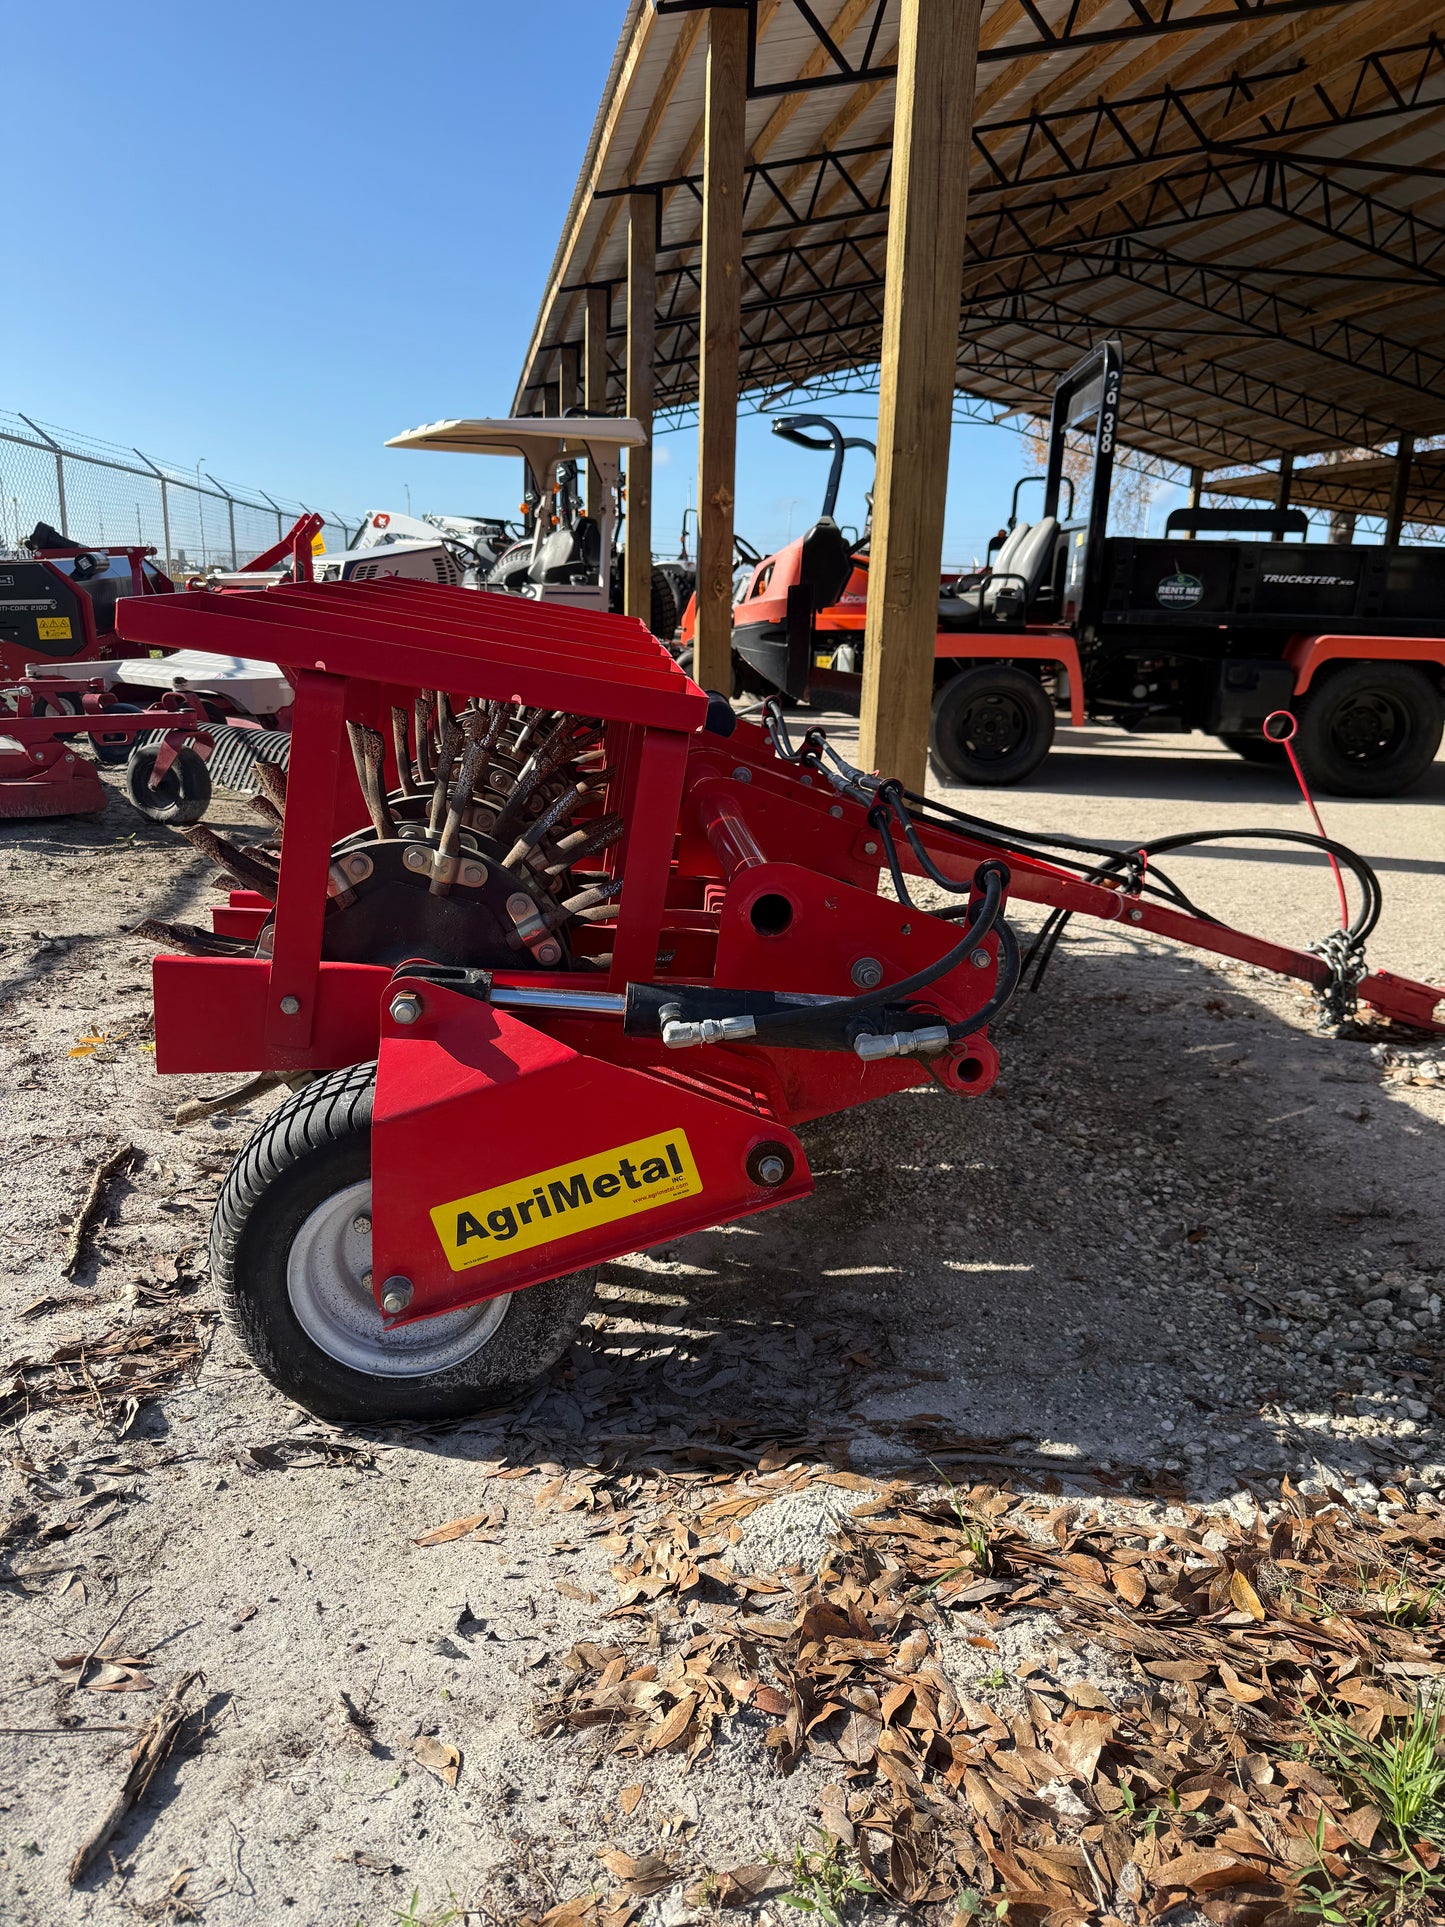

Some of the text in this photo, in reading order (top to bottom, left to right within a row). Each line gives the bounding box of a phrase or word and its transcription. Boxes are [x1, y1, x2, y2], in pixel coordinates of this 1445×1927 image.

[1262, 574, 1337, 585] TRUCKSTER
[1158, 586, 1201, 595] RENT ME
[671, 1175, 687, 1184] INC.
[456, 1143, 684, 1247] AgriMetal
[632, 1182, 689, 1204] www.agrimetal.com
